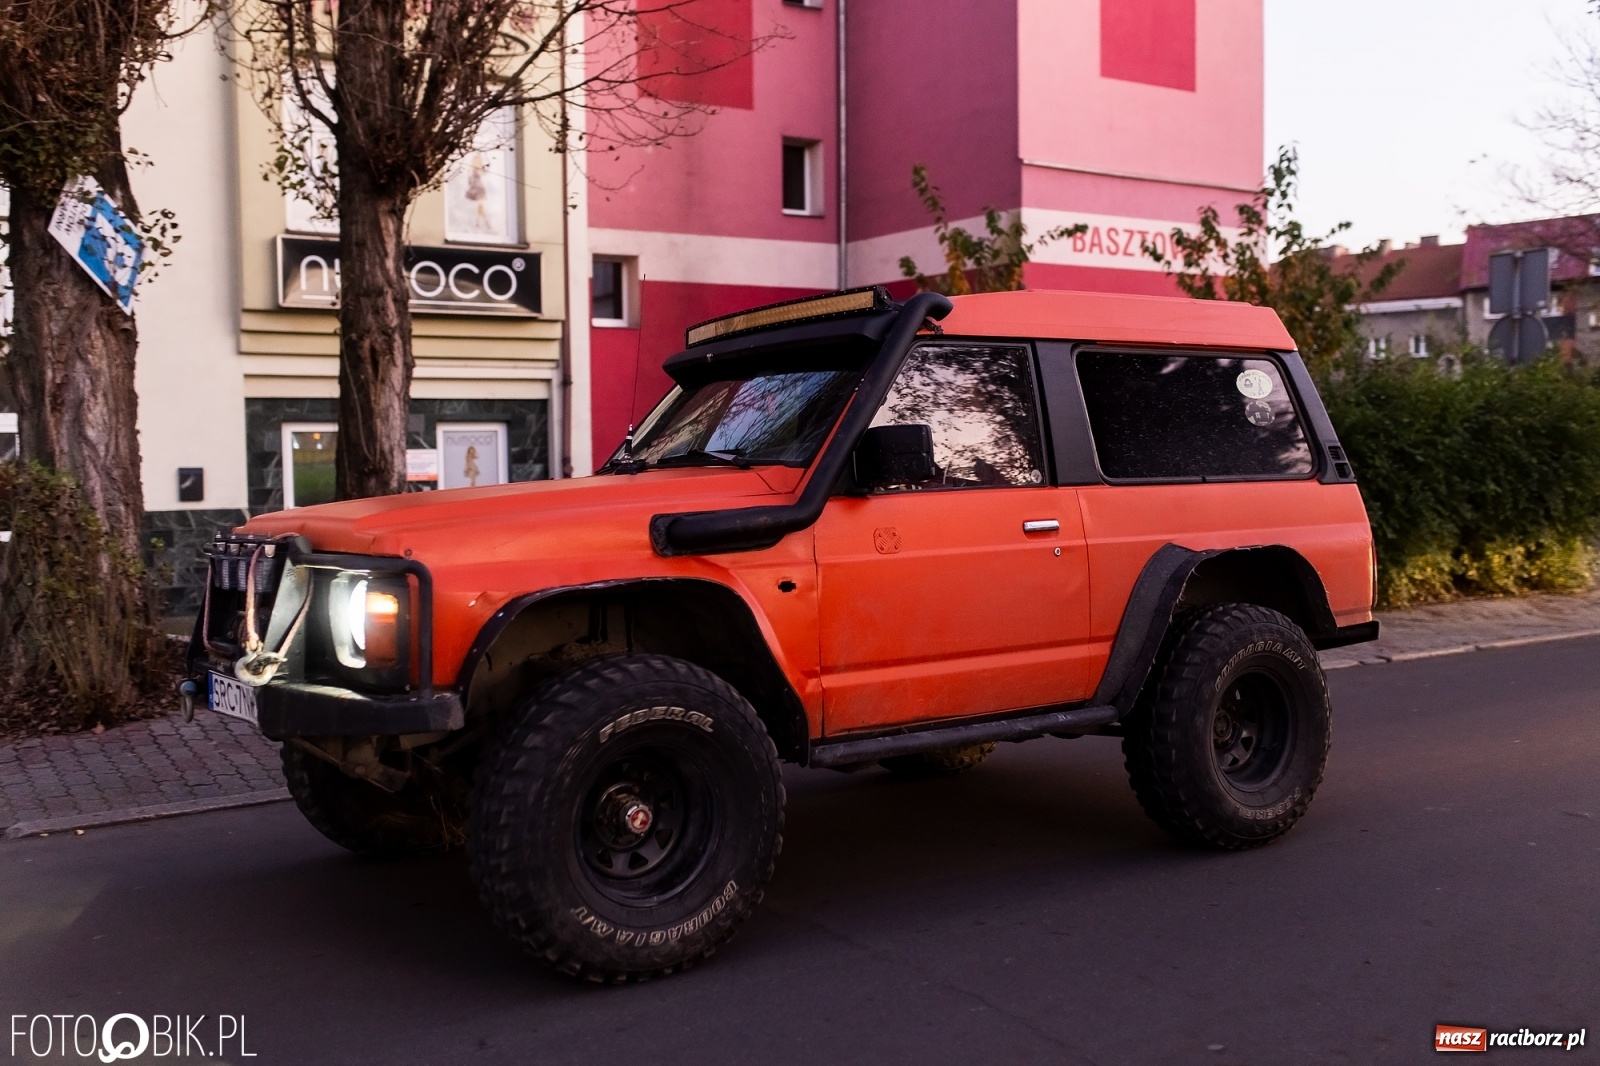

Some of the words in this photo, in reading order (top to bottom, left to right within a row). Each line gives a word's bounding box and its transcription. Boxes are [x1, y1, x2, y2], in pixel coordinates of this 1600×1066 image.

[300, 254, 518, 301] noco
[599, 705, 714, 744] FEDERAL
[616, 879, 738, 947] COURAGIA
